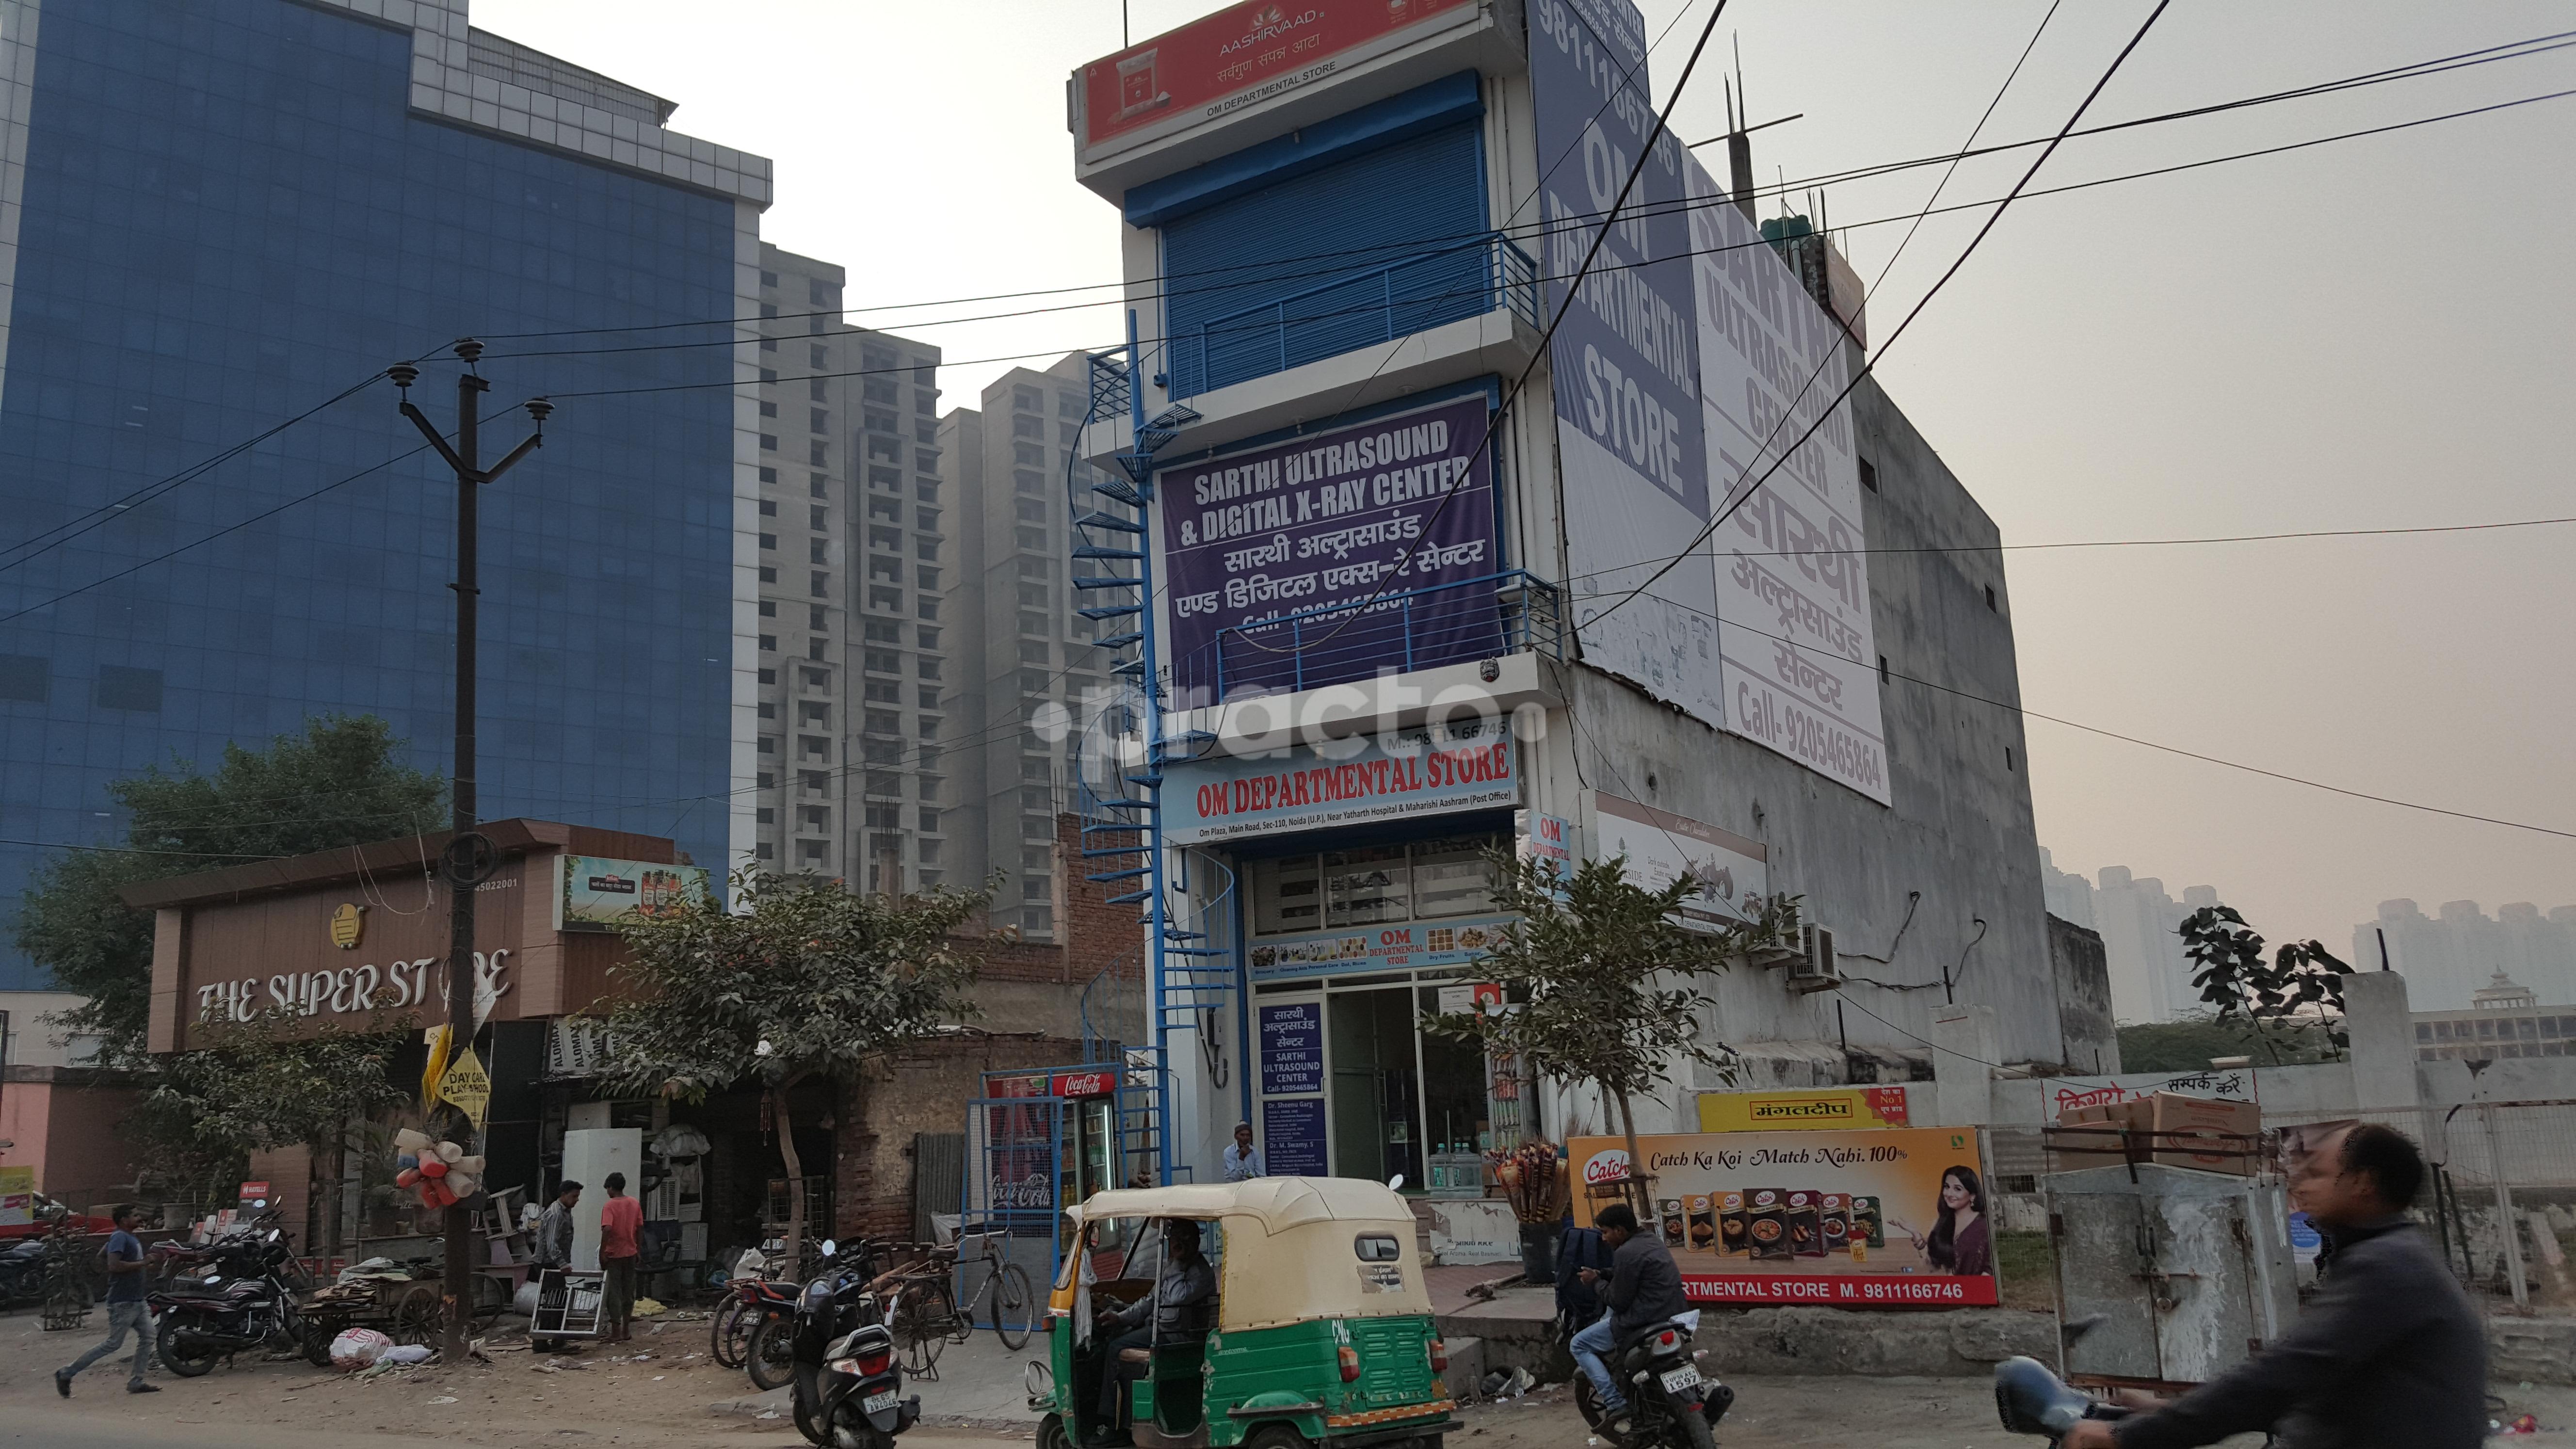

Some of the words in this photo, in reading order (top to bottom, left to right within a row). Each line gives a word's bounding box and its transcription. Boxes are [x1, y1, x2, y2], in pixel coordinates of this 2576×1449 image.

[1219, 10, 1317, 57] AASHIRVAAD
[1217, 59, 1253, 82] सर्वगुण
[1258, 46, 1286, 66] संपन्न
[1292, 33, 1320, 53] आटा
[1207, 104, 1222, 116] OM
[1224, 76, 1300, 110] DEPARTMENTAL
[1303, 61, 1336, 80] STORE
[1583, 117, 1647, 260] OM
[1689, 161, 1845, 396] SARTHI
[1549, 190, 1695, 400] DEPARTMENTAL
[1705, 266, 1849, 457] ULTRASOUND
[1583, 343, 1684, 497] STORE
[1746, 380, 1829, 497] CENTER
[1194, 458, 1280, 505] SARTHI
[1285, 420, 1449, 485] ULTRASOUND
[1181, 520, 1199, 547] &
[1202, 492, 1292, 542] DIGITAL
[1296, 478, 1372, 523] X-RAY
[1374, 455, 1470, 507] CENTER
[1224, 533, 1291, 573] सारथी
[1296, 510, 1422, 561] अल्ट्रासाउंड
[1719, 447, 1862, 615] सारथी
[1175, 589, 1220, 618] एण्ड
[1225, 572, 1316, 612] डिजिटल
[1417, 539, 1486, 574] सेन्टर
[1771, 637, 1844, 711] सेन्टर
[1415, 728, 1459, 747] 9811
[1737, 681, 1783, 743] Call-
[1787, 705, 1883, 790] 9205465864
[1197, 781, 1229, 818] OM
[1234, 755, 1422, 814] DEPARTMENTAL
[1427, 742, 1509, 789] STORE
[1211, 827, 1227, 836] Plaza,
[1229, 825, 1244, 834] Main
[1245, 823, 1261, 831] Road,
[1263, 820, 1288, 830] Sec-110,
[1289, 817, 1306, 826] Noida
[1343, 807, 1369, 820] Yatharth
[1371, 804, 1397, 817] Hospital
[1406, 799, 1438, 811] Maharishi
[1439, 797, 1468, 807] Aashram
[1470, 793, 1487, 805] (Post
[1488, 790, 1511, 802] Office)
[1540, 817, 1561, 842] OM
[1533, 842, 1570, 861] DEPARTMENTAL
[474, 878, 517, 892] 45022001
[1381, 928, 1411, 945] OM
[1369, 944, 1424, 956] DEPARTMENTAL
[1387, 956, 1409, 965] STORE
[197, 978, 261, 1023] THE
[269, 964, 382, 1017] SUPER
[1263, 1017, 1316, 1034] अल्ट्रासाउंड
[1273, 1006, 1304, 1020] सारथी
[1276, 1035, 1304, 1047] सेन्टर
[1263, 1062, 1320, 1073] ULTRASOUND
[1276, 1051, 1306, 1062] SARTHI
[449, 1072, 471, 1084] DAY
[1065, 1074, 1100, 1096] Coca-Cola
[1276, 1073, 1308, 1082] CENTER
[1300, 1101, 1314, 1109] Garg
[1755, 1102, 1848, 1117] मंगलदीप
[1587, 1156, 1630, 1181] Catch
[1651, 1151, 1689, 1171] Catch
[1694, 1151, 1713, 1171] Ka
[1718, 1150, 1741, 1170] Koi
[1749, 1148, 1809, 1166] Match
[1815, 1147, 1866, 1168] Nahi.
[1869, 1145, 1908, 1162] 100%
[1683, 1282, 1767, 1297] RTMENTAL
[1772, 1282, 1830, 1297] STORE
[1840, 1283, 1859, 1298] M.
[1864, 1282, 1963, 1298] 9811166746
